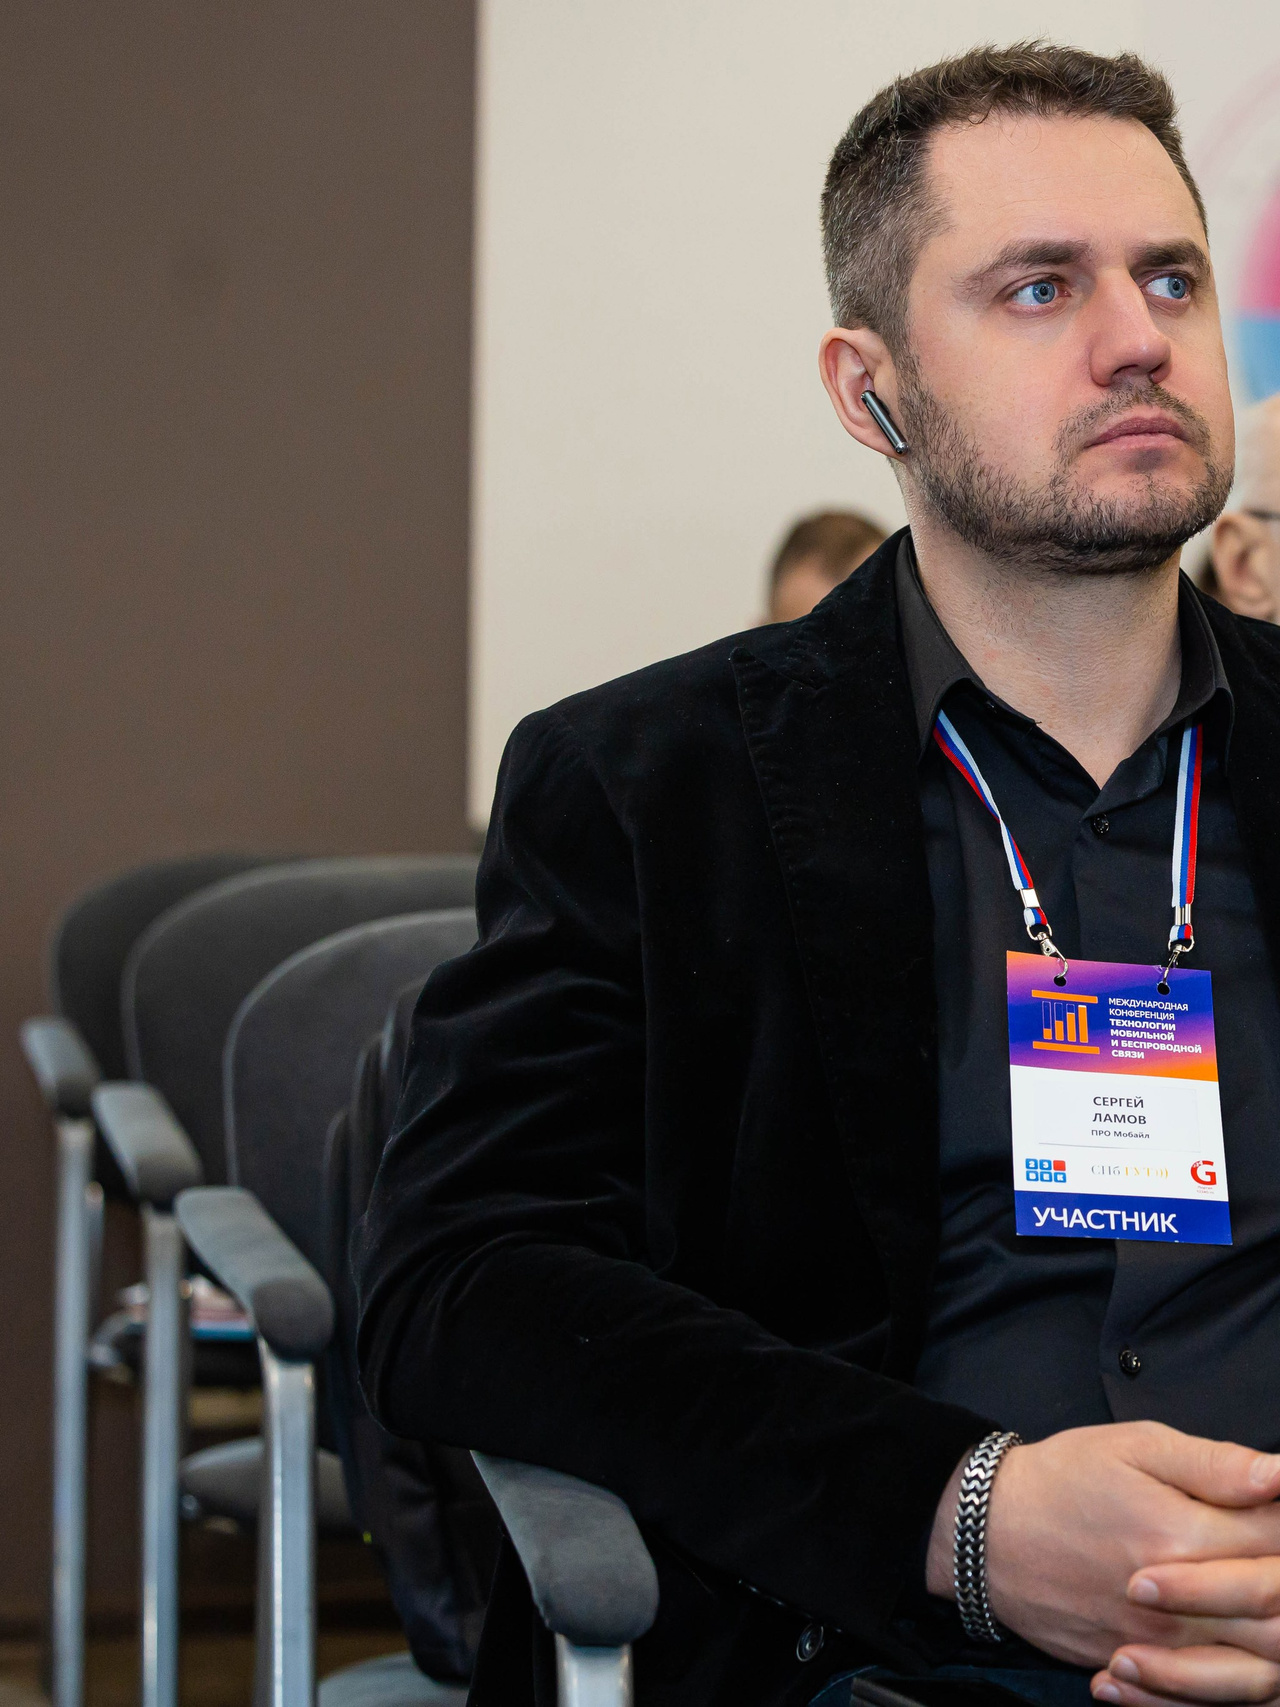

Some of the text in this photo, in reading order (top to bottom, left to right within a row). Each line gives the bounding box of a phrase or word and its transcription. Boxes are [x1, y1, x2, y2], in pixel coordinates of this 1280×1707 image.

[1108, 997, 1189, 1011] МЕЖДУНАРОДНАЯ
[1109, 1008, 1175, 1021] КОНФЕРЕНЦИЯ
[1109, 1018, 1176, 1031] ТЕХНОЛОГИИ
[1110, 1029, 1175, 1041] МОБИЛЬНОЙ
[1111, 1039, 1202, 1054] И БЕСПРОВОДНОЙ
[1111, 1049, 1145, 1059] СВЯЗИ
[1093, 1096, 1144, 1109] СЕРГЕЙ
[1092, 1113, 1147, 1125] ЛАМОВ
[1091, 1129, 1150, 1139] ПРО Мобайл
[1033, 1206, 1178, 1233] УЧАСТНИК
